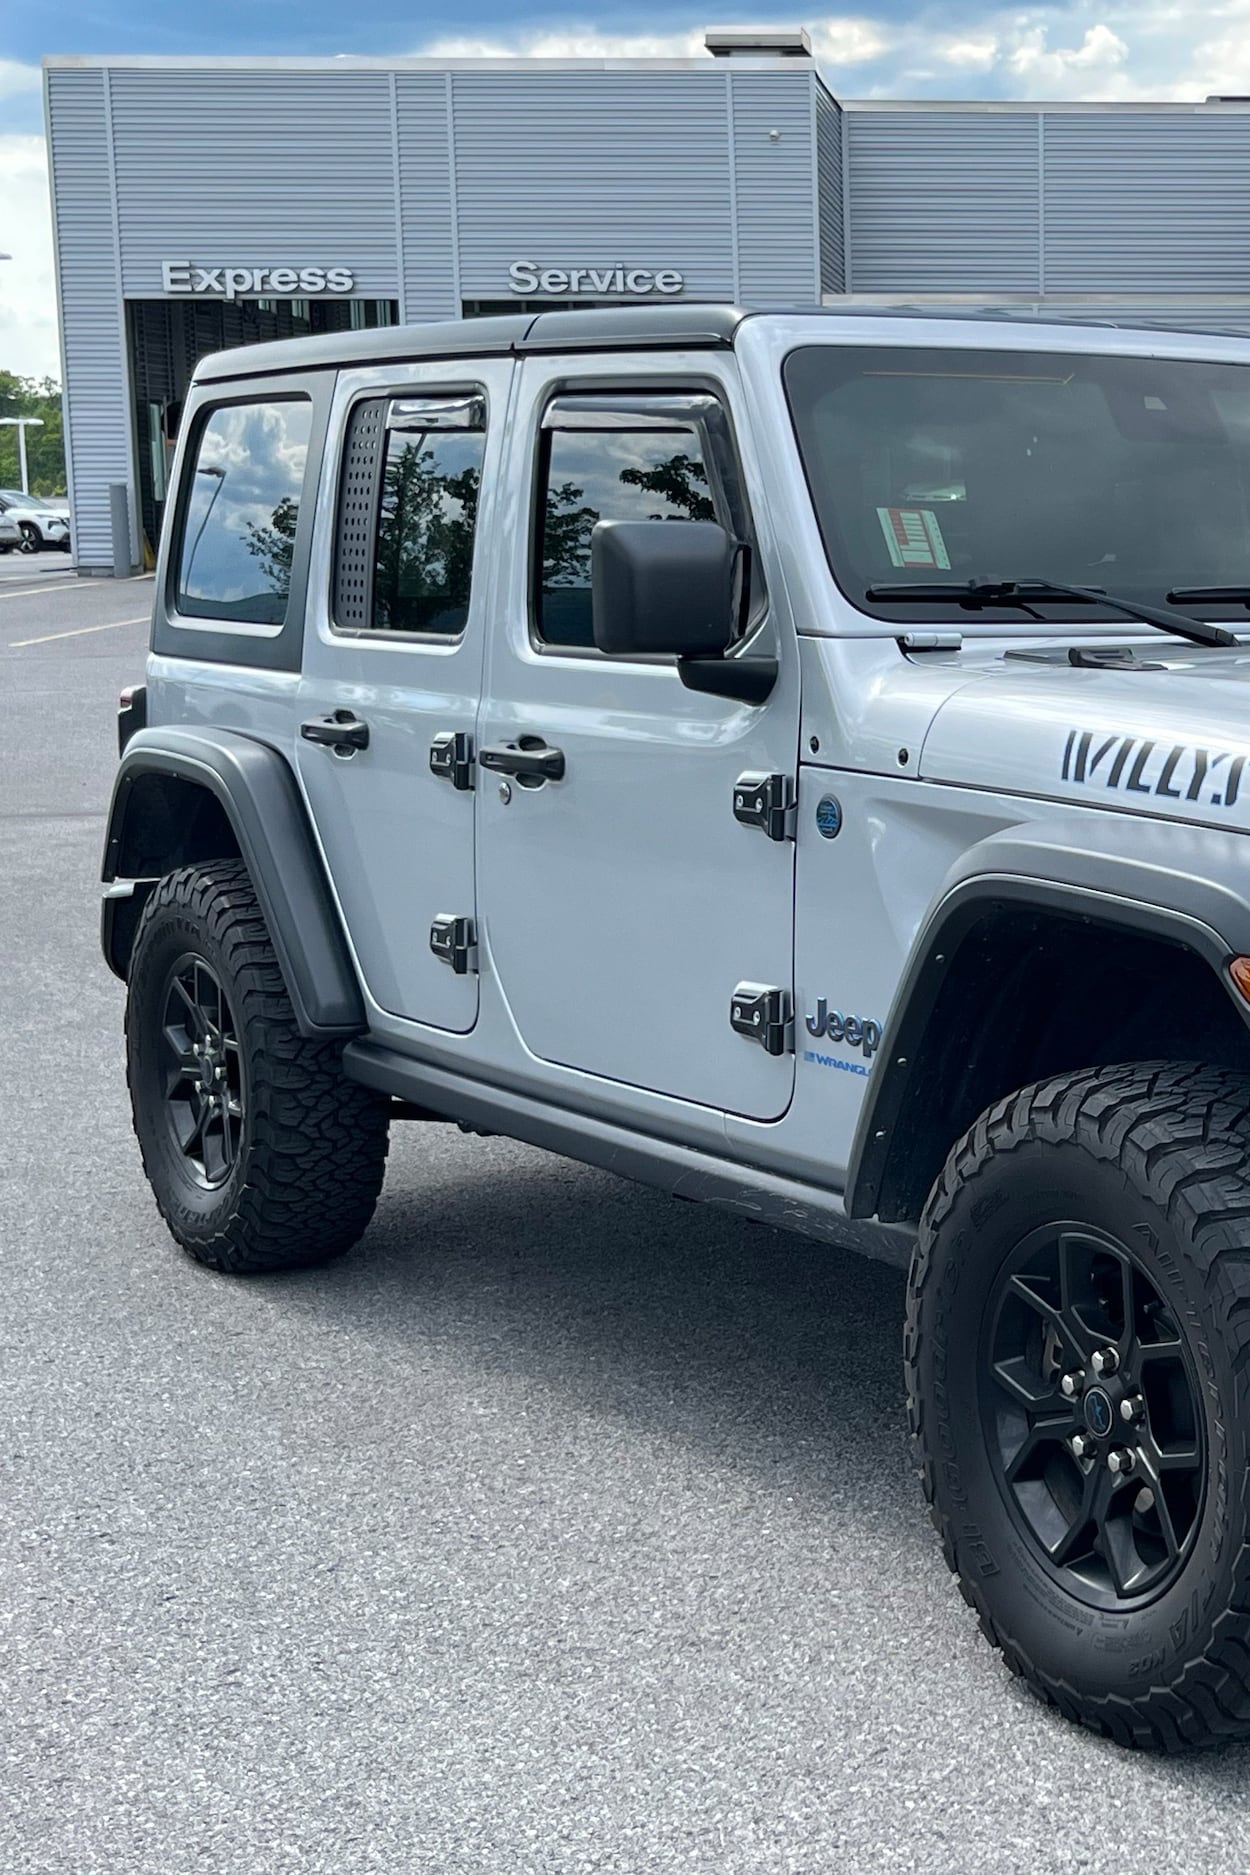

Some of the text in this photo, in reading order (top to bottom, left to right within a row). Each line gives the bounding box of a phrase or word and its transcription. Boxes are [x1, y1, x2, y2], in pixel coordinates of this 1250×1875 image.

[161, 260, 354, 299] Express
[508, 260, 683, 294] Service
[805, 996, 883, 1059] Jeep
